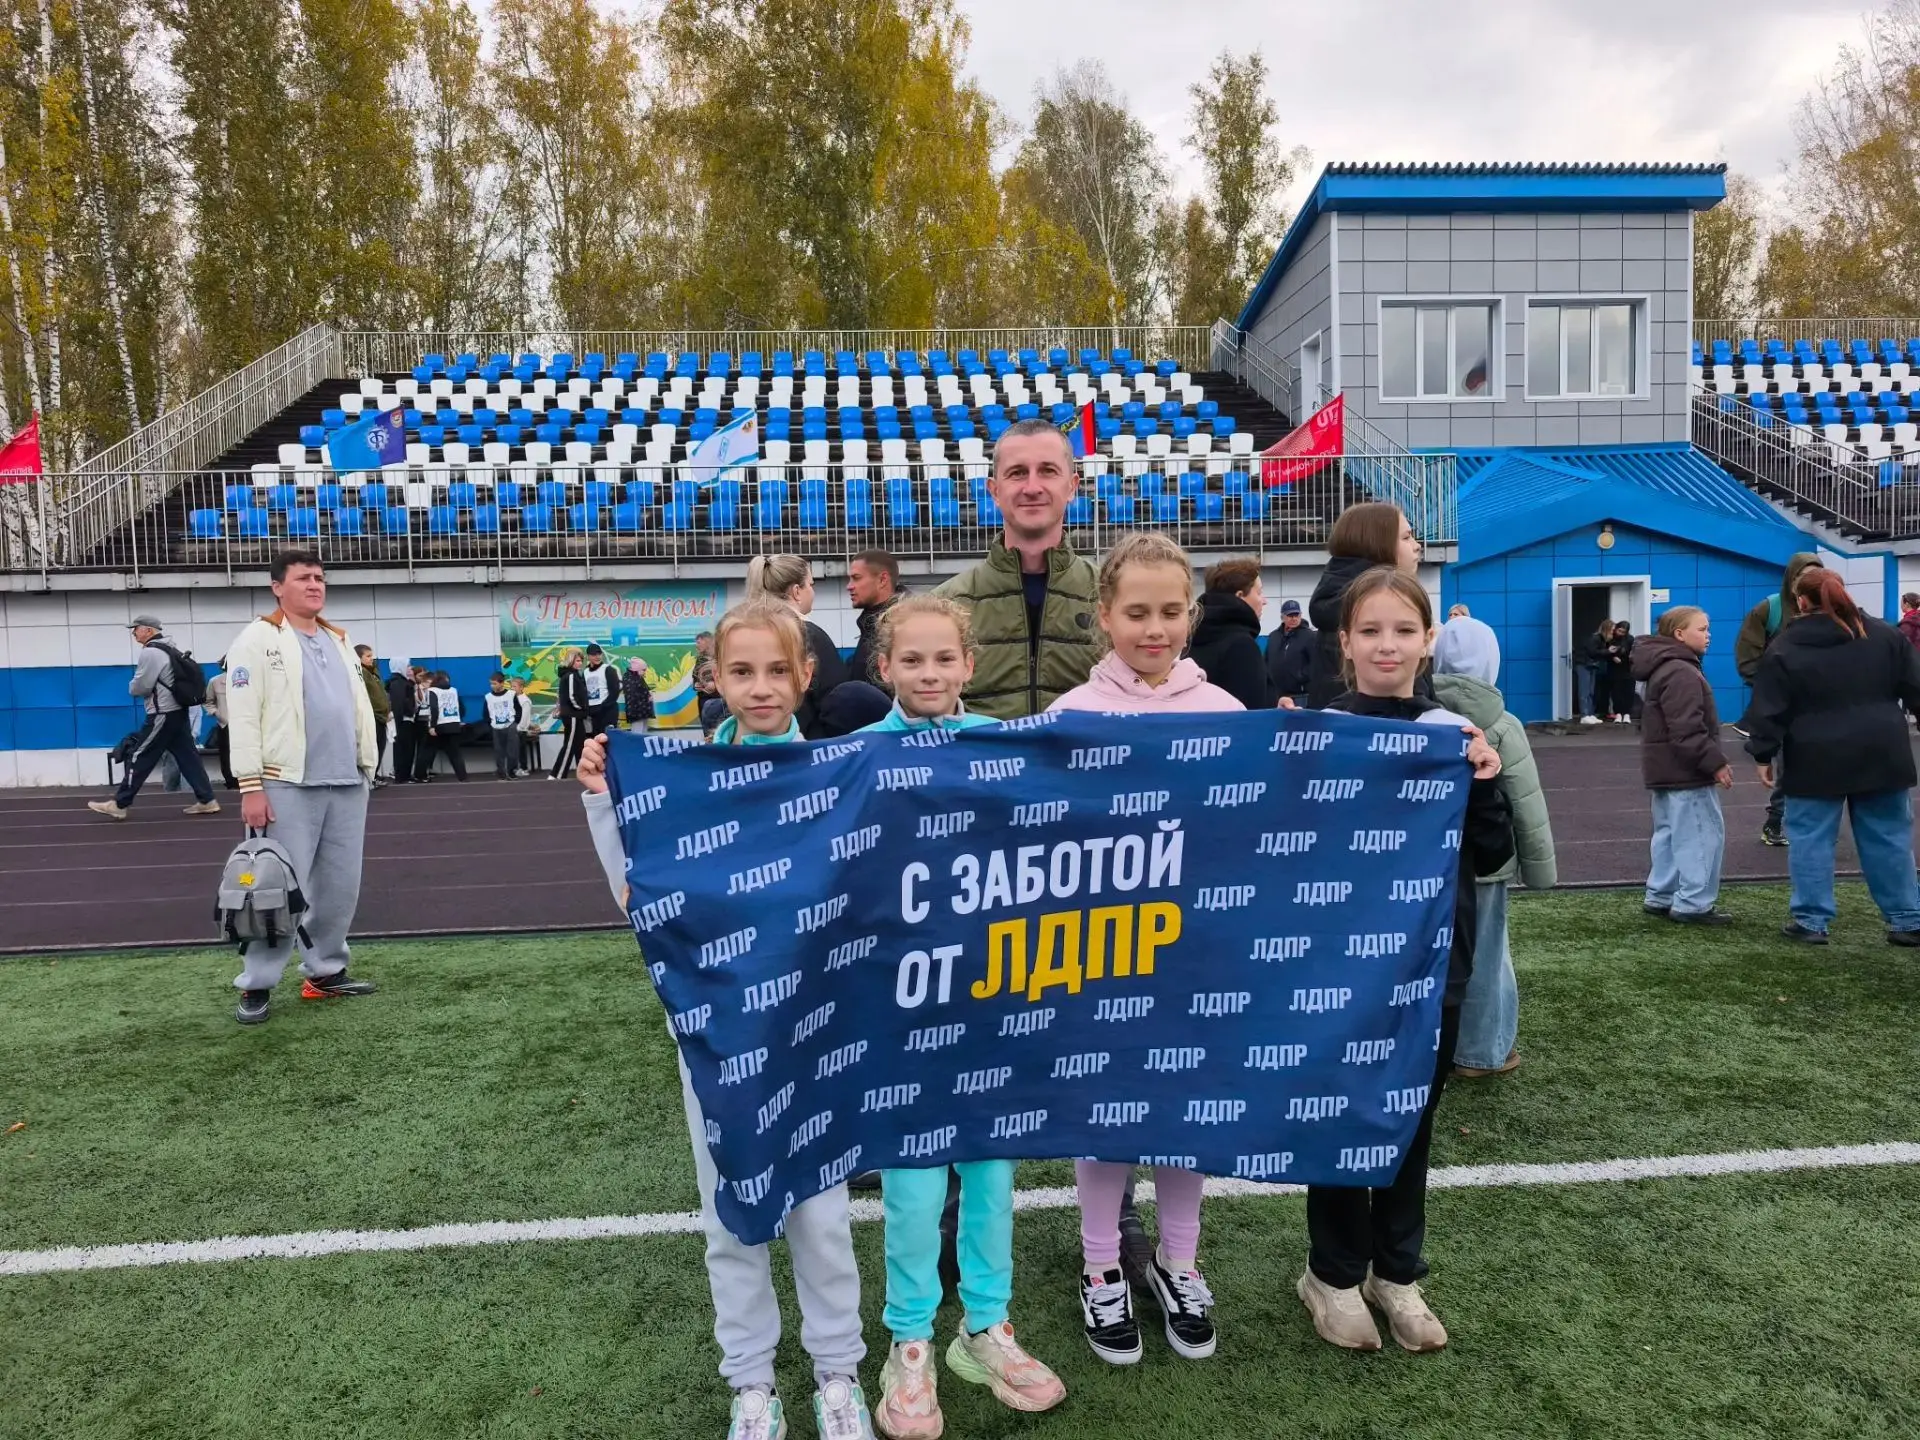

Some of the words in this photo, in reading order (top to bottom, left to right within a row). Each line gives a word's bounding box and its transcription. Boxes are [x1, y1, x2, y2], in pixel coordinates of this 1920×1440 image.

[512, 596, 530, 624] С
[537, 590, 716, 628] Праздником!
[811, 740, 865, 766] ЛДПР
[1166, 736, 1231, 762] ЛДПР
[1269, 731, 1333, 754] ЛДПР
[1368, 733, 1428, 755] ЛДПР
[968, 757, 1025, 781] ЛДПР
[1067, 745, 1131, 770] ЛДПР
[709, 761, 773, 791] ЛДПР
[876, 767, 933, 791] ЛДПР
[1109, 791, 1169, 817] ЛДПР
[1204, 782, 1266, 808] ЛДПР
[1302, 779, 1364, 802] ЛДПР
[1397, 780, 1454, 802] ЛДПР
[777, 787, 839, 825] ЛДПР
[1009, 800, 1069, 827] ЛДПР
[916, 811, 975, 839] ЛДПР
[675, 821, 739, 860] ЛДПР
[830, 825, 881, 861] ЛДПР
[1256, 831, 1317, 856] ЛДПР
[1349, 830, 1406, 853] ЛДПР
[727, 858, 791, 895] ЛДПР
[901, 862, 930, 924] С
[951, 818, 1185, 914] ЗАБОТОЙ
[1194, 885, 1255, 911] ЛДПР
[1293, 882, 1352, 906] ЛДПР
[1389, 877, 1443, 903] ЛДПР
[631, 890, 685, 933] ЛДПР
[795, 894, 848, 934] ЛДПР
[699, 927, 757, 968] ЛДПР
[824, 935, 877, 972] ЛДПР
[896, 943, 963, 1008] ОТ
[970, 902, 1182, 1001] ЛДПР
[1250, 936, 1311, 962] ЛДПР
[1345, 933, 1406, 958] ЛДПР
[742, 970, 802, 1013] ЛДПР
[1189, 992, 1251, 1017] ЛДПР
[1289, 988, 1352, 1013] ЛДПР
[1389, 977, 1435, 1007] ЛДПР
[998, 1008, 1055, 1037] ЛДПР
[1094, 997, 1154, 1022] ЛДПР
[792, 1002, 835, 1047] ЛДПР
[904, 1023, 965, 1052] ЛДПР
[815, 1040, 867, 1080] ЛДПР
[1144, 1048, 1205, 1072] ЛДПР
[1244, 1045, 1307, 1070] ЛДПР
[1342, 1038, 1395, 1065] ЛДПР
[718, 1047, 768, 1086] ЛДПР
[1051, 1052, 1110, 1079] ЛДПР
[953, 1066, 1012, 1094] ЛДПР
[756, 1081, 794, 1134] ЛДПР
[860, 1083, 921, 1113] ЛДПР
[1285, 1096, 1348, 1122] ЛДПР
[1383, 1085, 1429, 1115] ЛДП
[990, 1110, 1047, 1139] ЛДПР
[1088, 1102, 1149, 1127] ЛДПР
[1184, 1100, 1246, 1125] ЛДПР
[788, 1111, 832, 1158] ЛДПР
[899, 1125, 956, 1158] ЛДПР
[819, 1144, 862, 1190] ЛДПР
[1232, 1152, 1294, 1179] ЛДПР
[1336, 1145, 1398, 1171] ЛДПР
